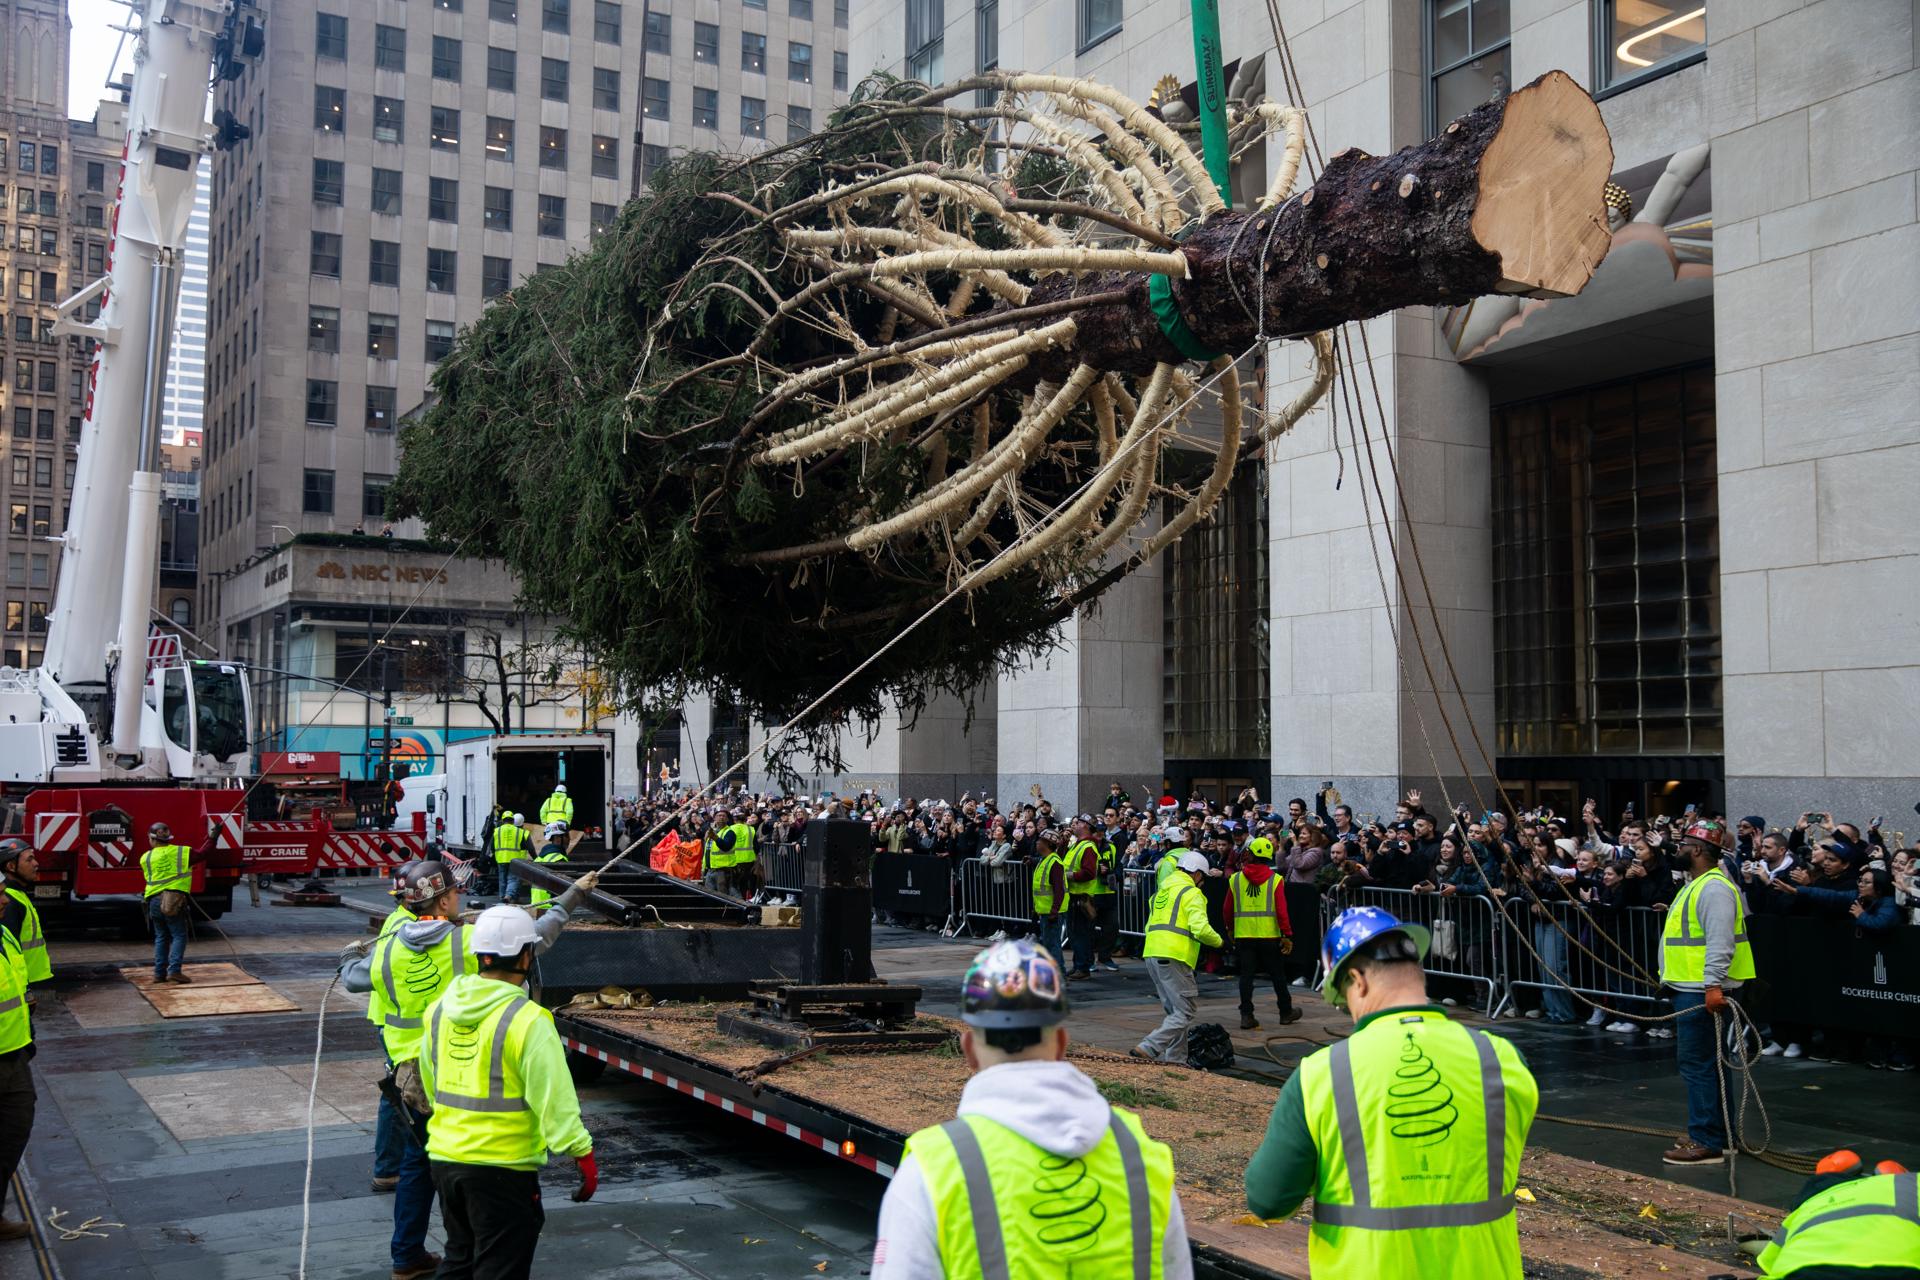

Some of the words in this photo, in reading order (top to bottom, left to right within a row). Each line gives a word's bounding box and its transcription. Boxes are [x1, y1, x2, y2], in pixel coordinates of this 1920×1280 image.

[1203, 45, 1216, 102] SLINGMAX
[351, 564, 391, 581] NBC
[396, 566, 448, 584] NEWS
[244, 848, 263, 857] BAY
[270, 847, 307, 856] CRANE
[1842, 986, 1894, 1001] ROCKEFELLER
